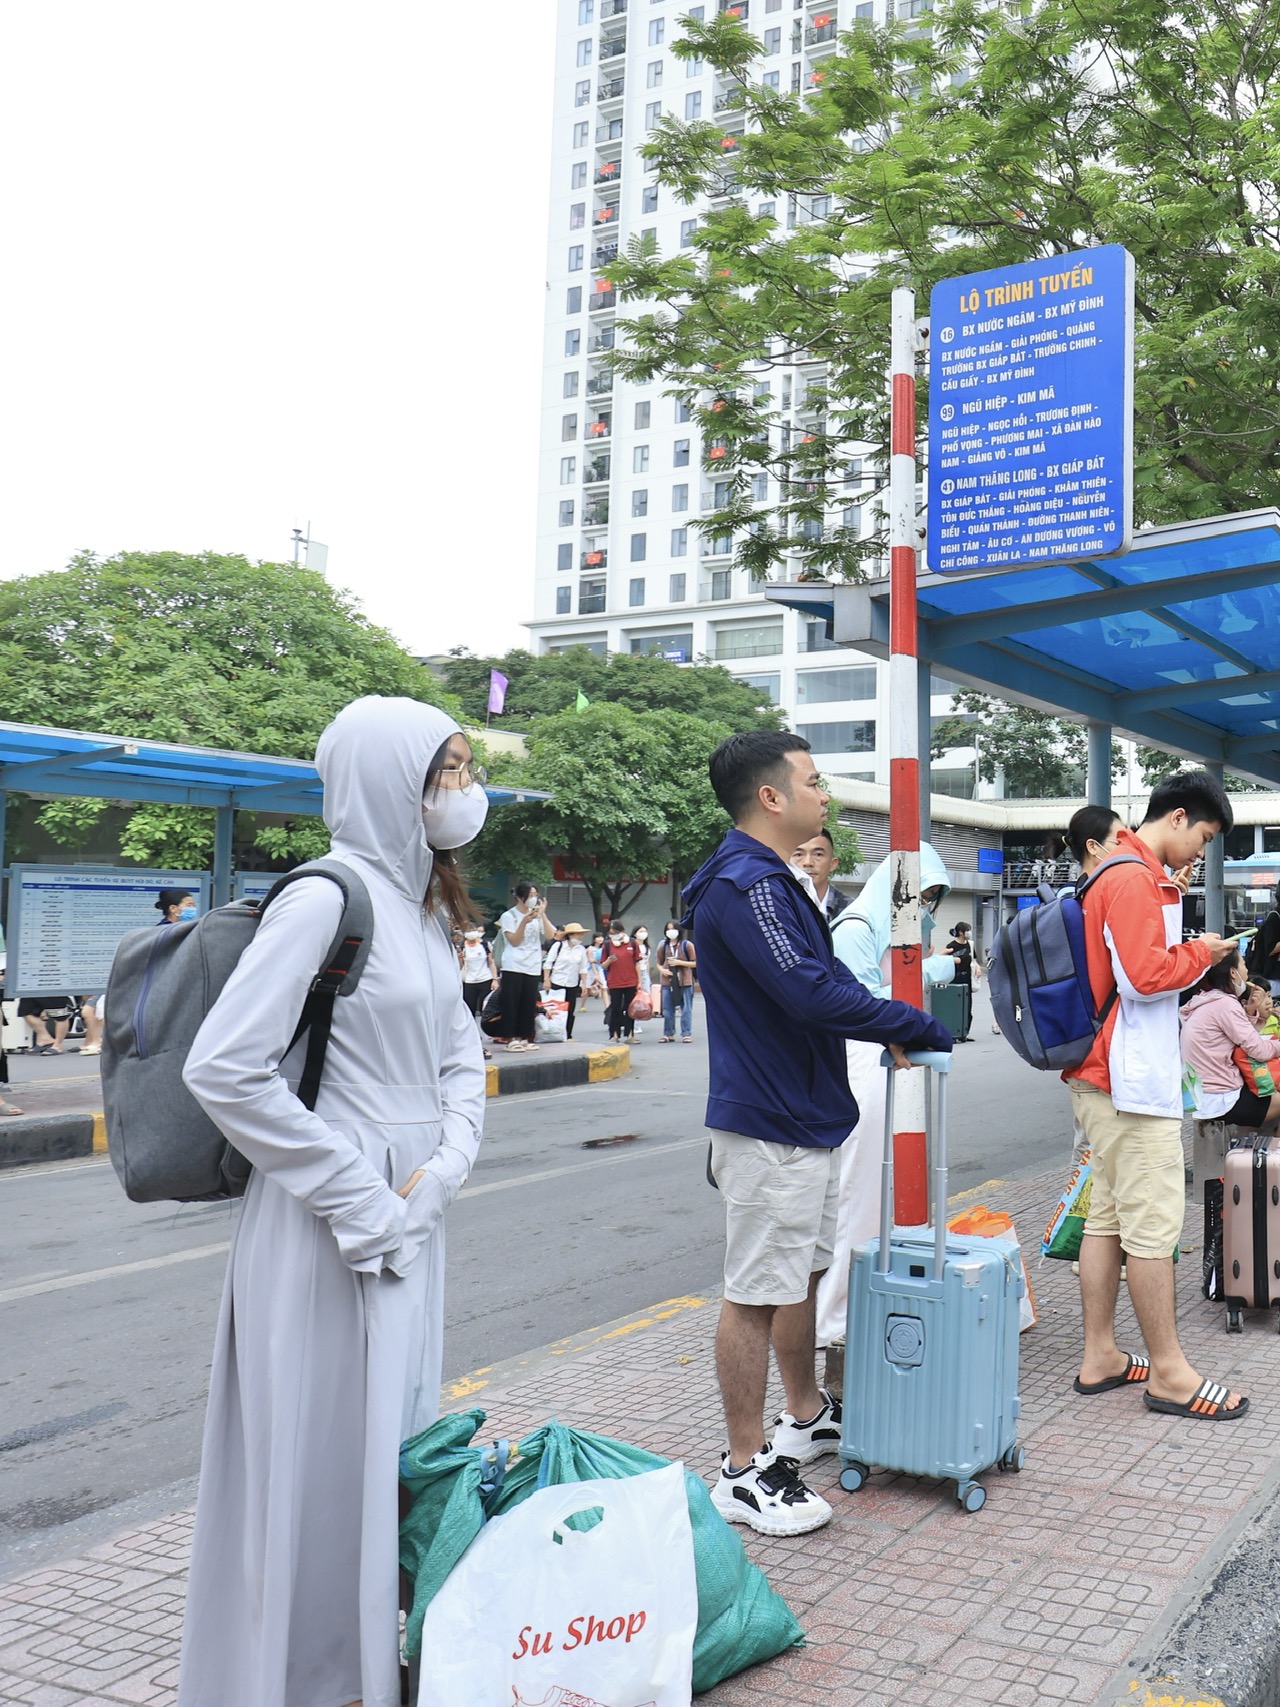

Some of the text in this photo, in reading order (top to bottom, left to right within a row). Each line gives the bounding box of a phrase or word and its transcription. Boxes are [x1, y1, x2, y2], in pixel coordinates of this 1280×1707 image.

[960, 262, 1093, 315] LỘ TRÌNH TUYẾN
[962, 324, 975, 337] BX
[978, 318, 1004, 334] NƯỚC
[1045, 306, 1058, 319] BX
[1061, 299, 1076, 316] MỸ
[1078, 295, 1104, 311] ĐÌNH
[942, 351, 952, 362] BX
[954, 346, 977, 360] NƯỚC
[1011, 335, 1027, 348] GIẢI
[1030, 330, 1058, 344] PHÓNG
[942, 362, 974, 376] TRƯỜNG
[976, 360, 987, 370] BX
[989, 354, 1008, 368] GIÁP
[1010, 350, 1026, 363] BÁT
[1034, 343, 1067, 359] TRƯỜNG
[1070, 336, 1096, 351] CHINH
[987, 374, 998, 384] BX
[1000, 369, 1013, 382] MỸ
[1014, 367, 1035, 379] ĐÌNH
[963, 399, 982, 414] NGŨ
[985, 395, 1008, 411] HIỆP
[1018, 391, 1036, 405] KIM
[1039, 385, 1055, 401] MÃ
[942, 426, 959, 439] NGŨ
[961, 424, 980, 436] HIỆP
[988, 419, 1010, 431] NGỌC
[1036, 407, 1069, 423] TRƯƠNG
[1071, 403, 1092, 418] ĐỊNH
[942, 440, 958, 454] PHỐ
[960, 439, 983, 451] VỌNG
[991, 432, 1025, 446] PHƯƠNG
[1027, 428, 1043, 439] MAI
[1052, 423, 1062, 435] XÃ
[1064, 420, 1081, 433] ĐÀN
[941, 457, 959, 468] NAM
[968, 451, 992, 464] GIẢNG
[995, 448, 1006, 460] VÕ
[1015, 446, 1030, 457] KIM
[1033, 441, 1046, 454] MÃ
[957, 477, 977, 489] NAM
[980, 471, 1010, 487] THĂNG
[1013, 468, 1037, 483] LONG
[1047, 465, 1059, 478] BX
[1062, 459, 1084, 474] GIÁP
[1087, 456, 1105, 470] BÁT
[942, 500, 952, 509] BX
[954, 496, 973, 507] GIÁP
[975, 494, 991, 504] BÁT
[999, 489, 1015, 501] GIẢI
[1018, 486, 1046, 498] PHÓNG
[1055, 481, 1079, 493] KHÂM
[1082, 477, 1106, 489] THIÊN
[941, 512, 957, 523] TÔN
[959, 508, 976, 521] ĐỨC
[1014, 501, 1042, 514] HOÀNG
[1044, 498, 1063, 510] DIỆU
[992, 519, 1019, 531] THÁNH
[1028, 514, 1057, 526] ĐƯỜNG
[1059, 510, 1087, 522] THANH
[1090, 506, 1109, 518] NIÊN
[941, 544, 960, 554] NGHI
[988, 537, 999, 548] ÂU
[1001, 536, 1013, 546] CƠ
[1021, 533, 1032, 544] AN
[1035, 529, 1063, 542] DƯƠNG
[1066, 525, 1094, 538] VƯƠNG
[1104, 521, 1115, 532] VÕ
[941, 559, 954, 568] CHÍ
[957, 555, 978, 566] CÔNG
[987, 550, 1008, 563] XUÂN
[1011, 551, 1021, 559] LA
[1029, 547, 1048, 557] NAM
[1050, 543, 1078, 554] THĂNG
[1081, 540, 1103, 551] LONG
[512, 1610, 646, 1660] Su Shop
